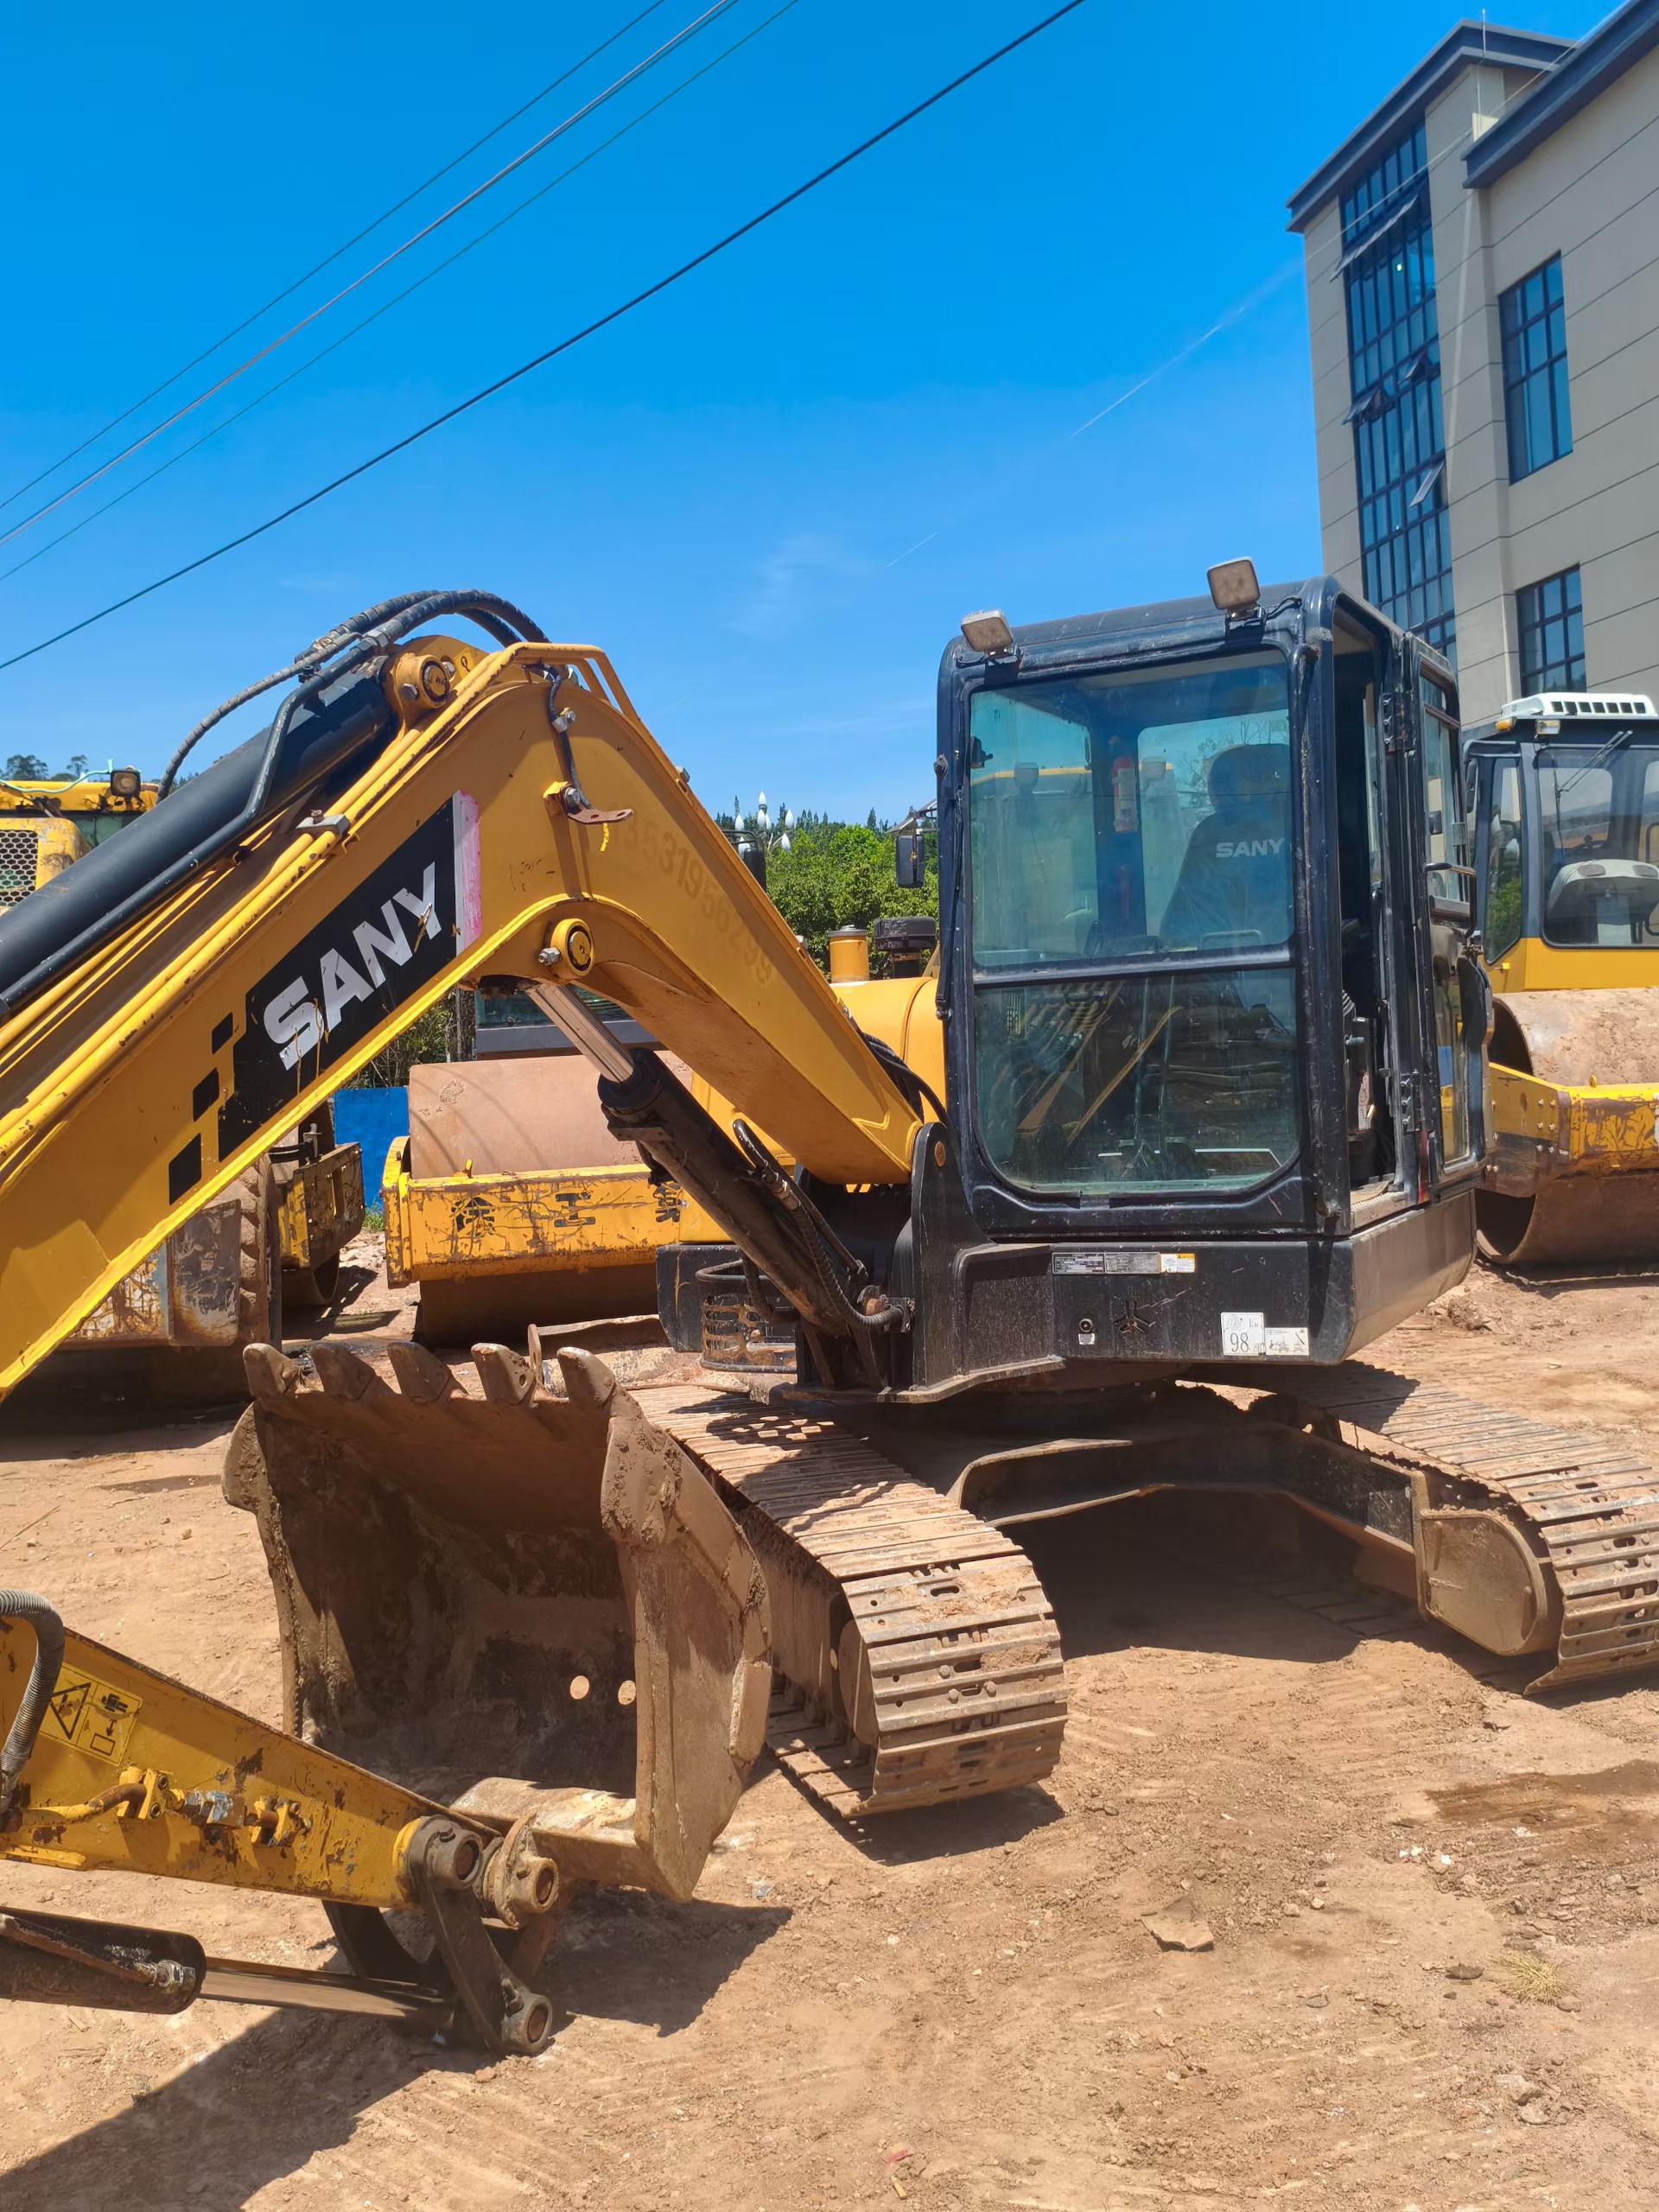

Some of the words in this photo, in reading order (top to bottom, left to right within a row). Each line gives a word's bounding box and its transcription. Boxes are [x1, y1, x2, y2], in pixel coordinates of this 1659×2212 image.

[1215, 837, 1285, 858] SANY
[264, 861, 442, 1071] SANY
[1230, 1332, 1249, 1352] 98
